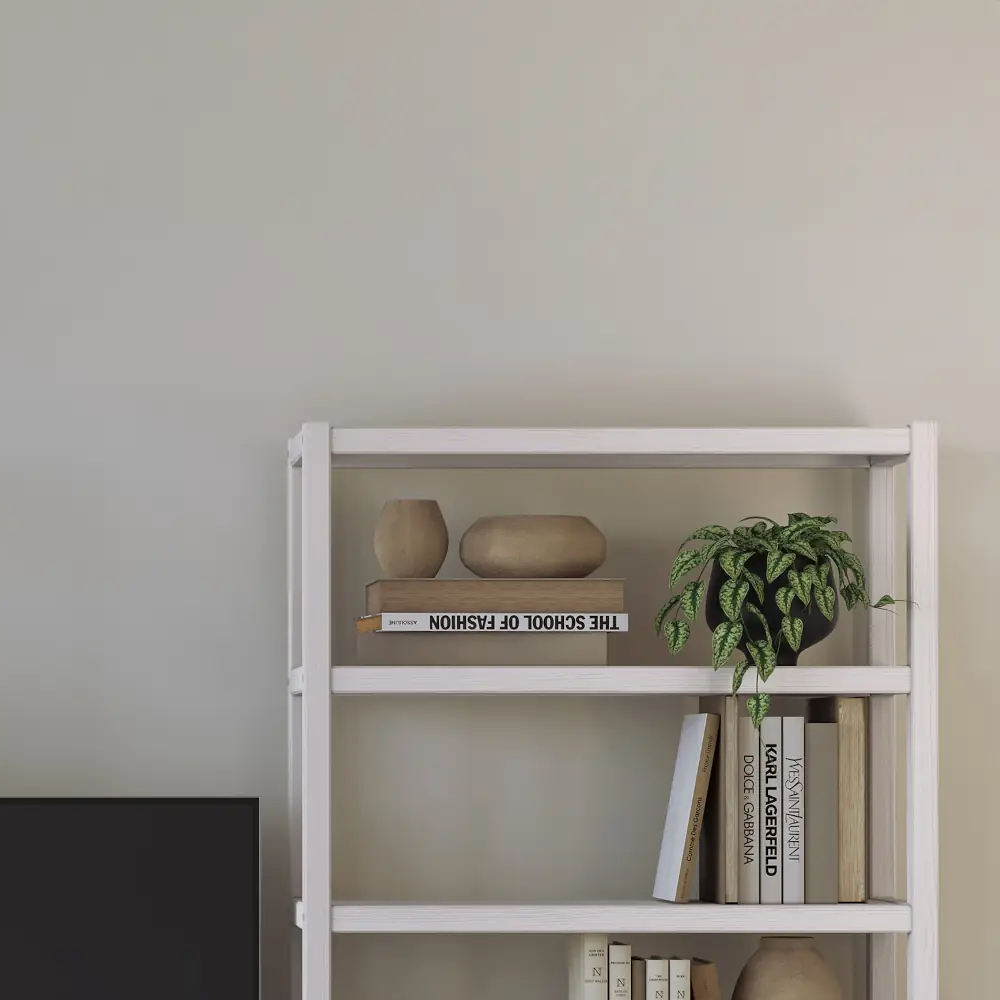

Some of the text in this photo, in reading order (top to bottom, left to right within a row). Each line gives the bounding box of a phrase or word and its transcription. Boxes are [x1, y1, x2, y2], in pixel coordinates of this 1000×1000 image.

[430, 615, 619, 630] THE SCHOOL OF FASHION
[743, 754, 754, 794] DOLCE
[765, 743, 777, 877] KARL LAGERFELD
[689, 824, 698, 836] Des
[743, 802, 754, 865] GABBANA
[685, 836, 695, 862] Comme
[592, 967, 602, 977] N
[616, 978, 626, 987] N
[655, 990, 664, 999] N
[677, 990, 685, 999] N
